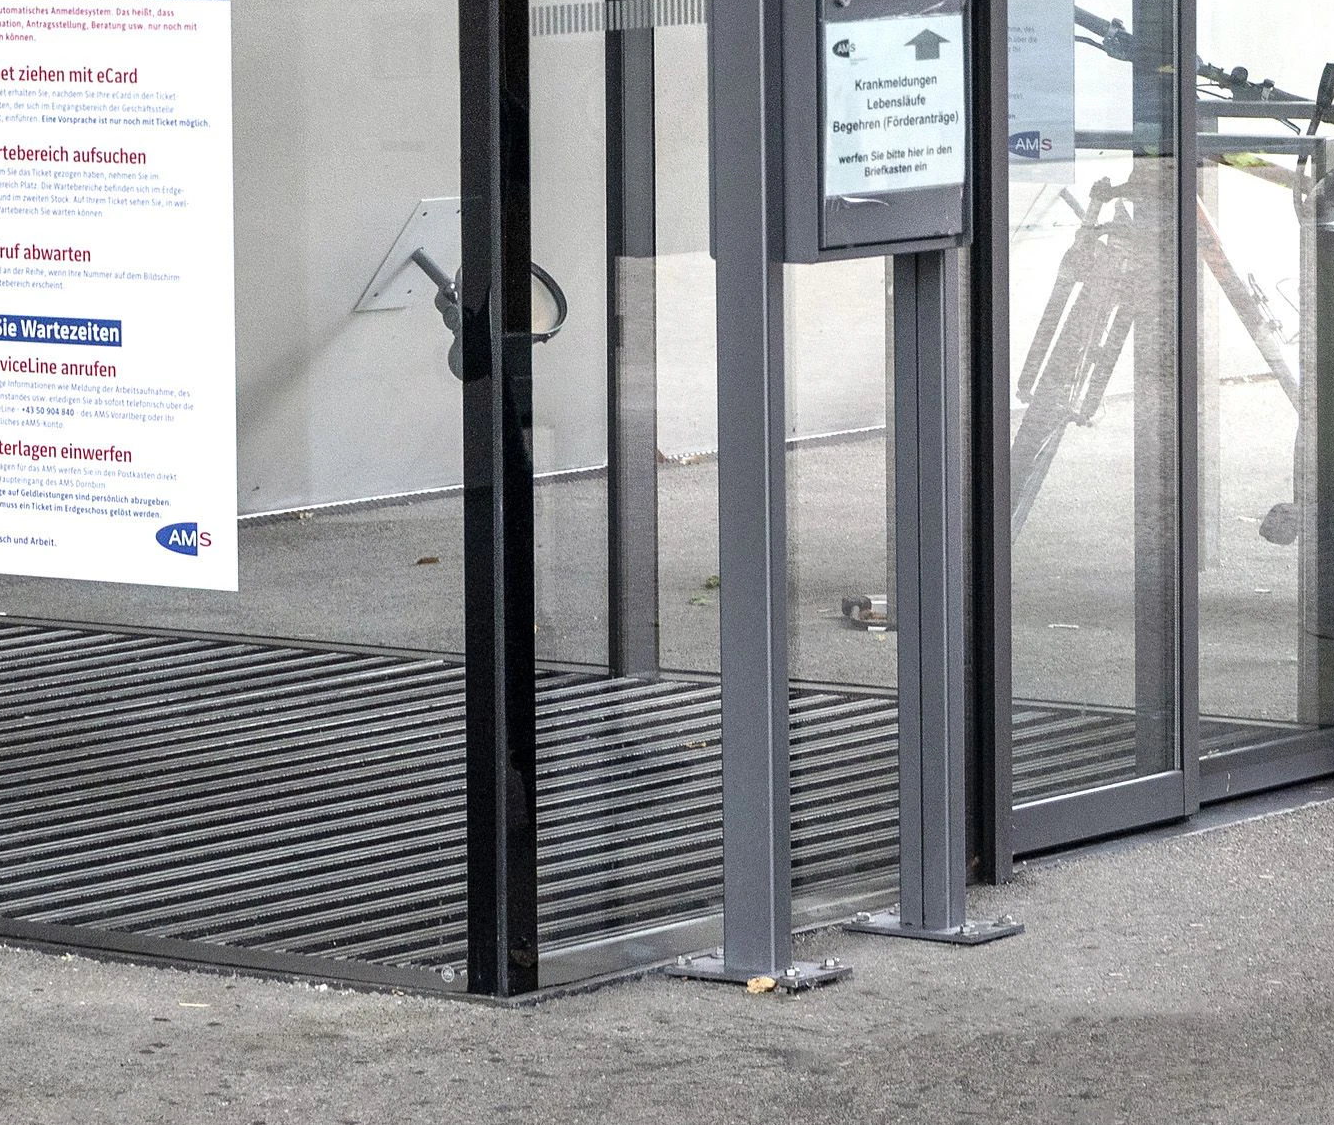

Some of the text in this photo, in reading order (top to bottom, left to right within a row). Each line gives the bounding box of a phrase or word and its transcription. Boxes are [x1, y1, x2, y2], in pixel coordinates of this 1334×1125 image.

[50, 6, 113, 16] Anmeldesystem.
[115, 7, 129, 16] Das
[131, 7, 156, 17] heißt,
[156, 8, 174, 16] dass
[26, 20, 90, 30] Antragsstellung,
[90, 20, 126, 31] Beratung
[162, 22, 181, 30] noch
[5, 33, 35, 41] können.
[18, 65, 64, 81] ziehen
[68, 66, 92, 82] mit
[96, 67, 137, 83] eCard
[855, 76, 937, 91] Krankmeldungen
[867, 94, 925, 109] Lebensläufe
[833, 111, 959, 134] Begehren (Förderanträge)
[1015, 138, 1051, 151] AMS
[73, 146, 146, 164] aufsuchen
[839, 145, 952, 164] werfen Sie bitte hier in den
[865, 162, 927, 177] Briefkasten ein
[23, 244, 91, 263] abwarten
[21, 319, 119, 342] Wartezeiten
[61, 359, 116, 377] anrufen
[60, 446, 131, 462] einwerfen
[7, 488, 19, 496] auf
[20, 488, 73, 501] Geldleistungen
[74, 492, 90, 500] sind
[91, 493, 128, 504] persönlich
[130, 496, 171, 507] abzugeben.
[31, 502, 52, 511] Ticket
[53, 503, 63, 511] im
[64, 504, 107, 516] Erdgeschoss
[109, 507, 131, 518] gelöst
[132, 509, 161, 518] werden.
[13, 535, 28, 544] und
[30, 536, 56, 546] Arbeit.
[169, 530, 212, 547] AMS
